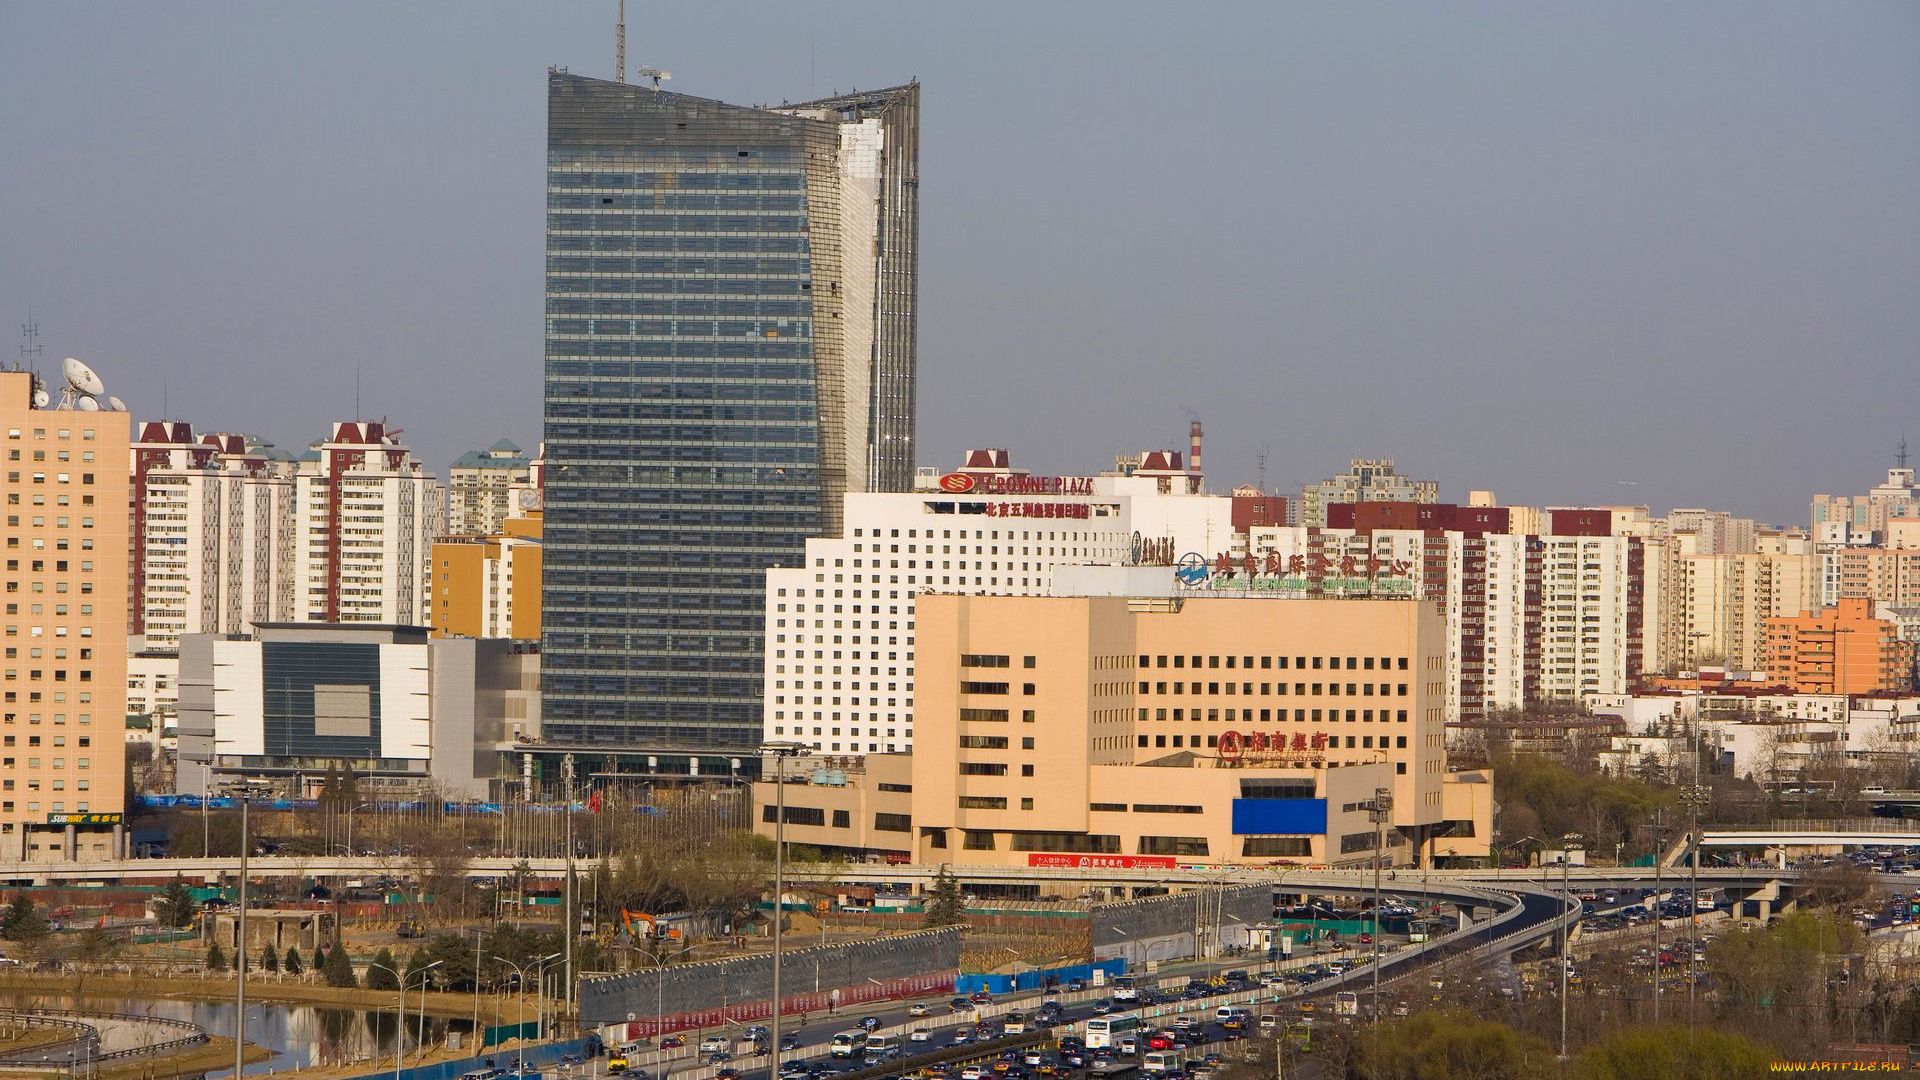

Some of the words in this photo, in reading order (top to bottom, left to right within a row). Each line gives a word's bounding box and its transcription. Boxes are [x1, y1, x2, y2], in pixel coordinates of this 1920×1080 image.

[985, 476, 1049, 494] CROWNE
[1054, 476, 1092, 494] PLAZA
[1216, 551, 1410, 583] 北京国际会议中心
[1251, 731, 1328, 752] 招商银行
[51, 815, 87, 823] SUBWAY
